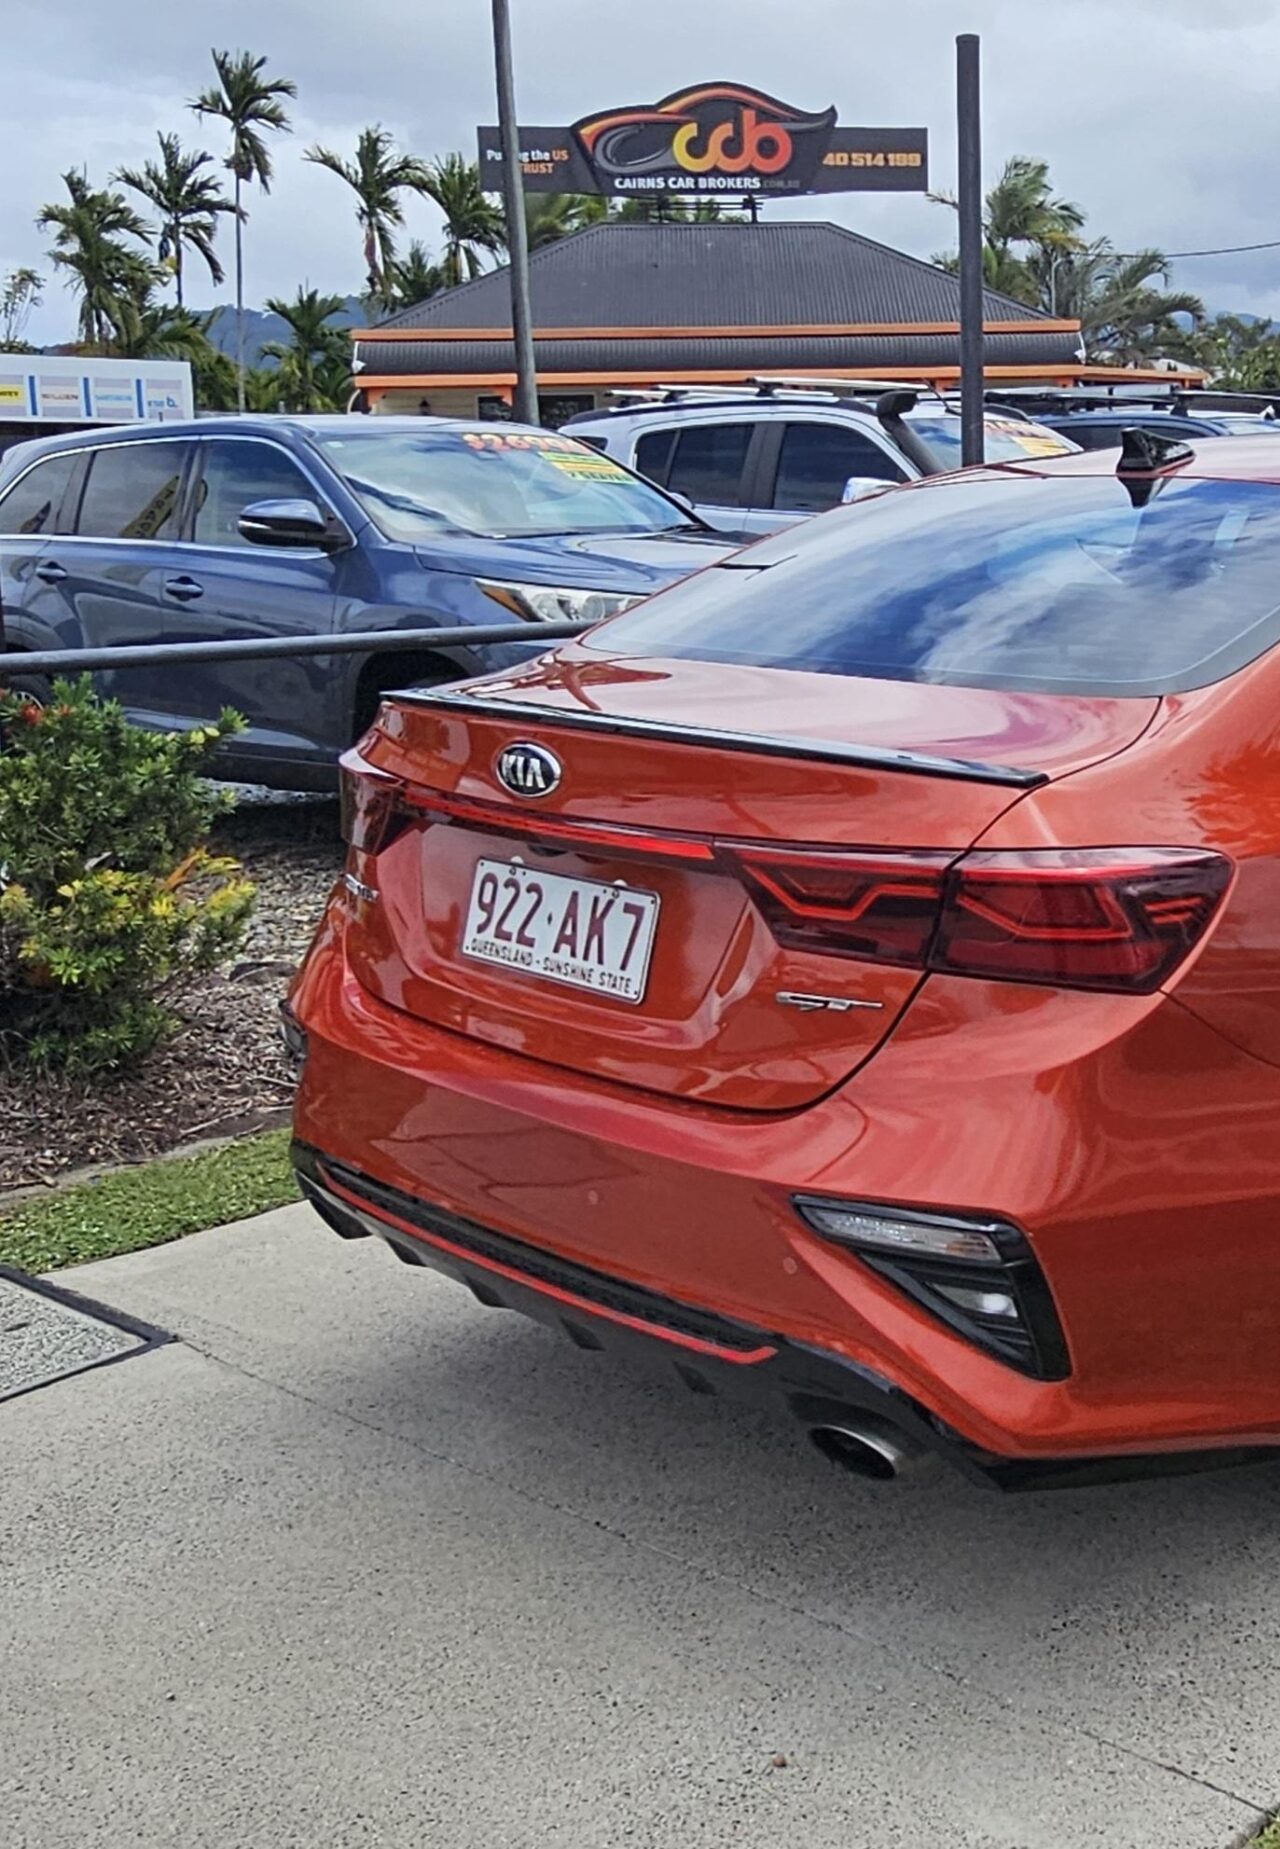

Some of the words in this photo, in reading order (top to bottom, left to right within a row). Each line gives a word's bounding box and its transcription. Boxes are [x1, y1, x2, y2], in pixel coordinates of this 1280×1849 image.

[531, 149, 550, 161] the
[552, 149, 569, 161] US
[851, 152, 885, 167] 514
[614, 177, 665, 189] CAIRNS
[667, 177, 695, 189] CAR
[698, 177, 761, 189] BROKERS
[501, 753, 546, 789] KIA
[471, 938, 533, 966] QUEENSLAND
[543, 956, 594, 983] SUNSHINE
[599, 972, 632, 994] STATE
